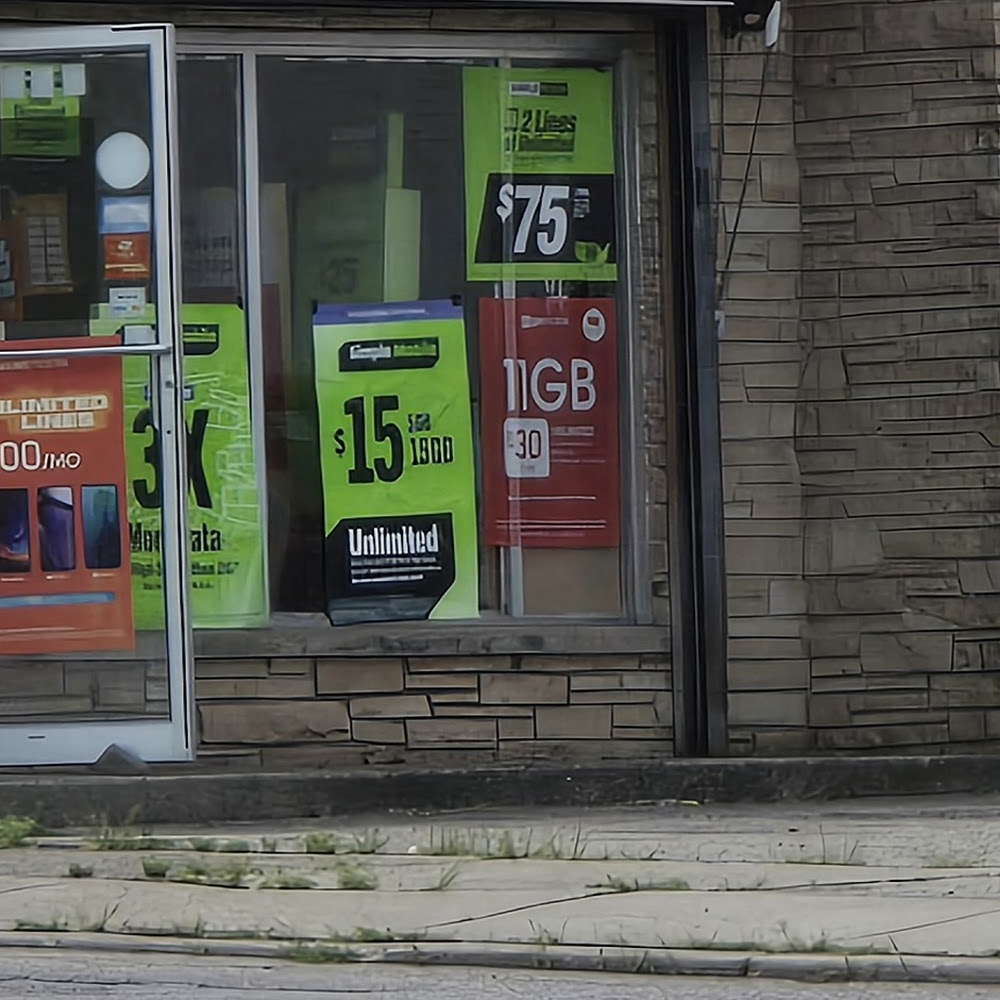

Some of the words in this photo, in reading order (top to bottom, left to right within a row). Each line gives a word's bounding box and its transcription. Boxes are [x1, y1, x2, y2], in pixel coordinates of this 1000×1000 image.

[496, 183, 570, 255] $75
[334, 395, 405, 484] $15
[348, 524, 439, 556] Unlimited
